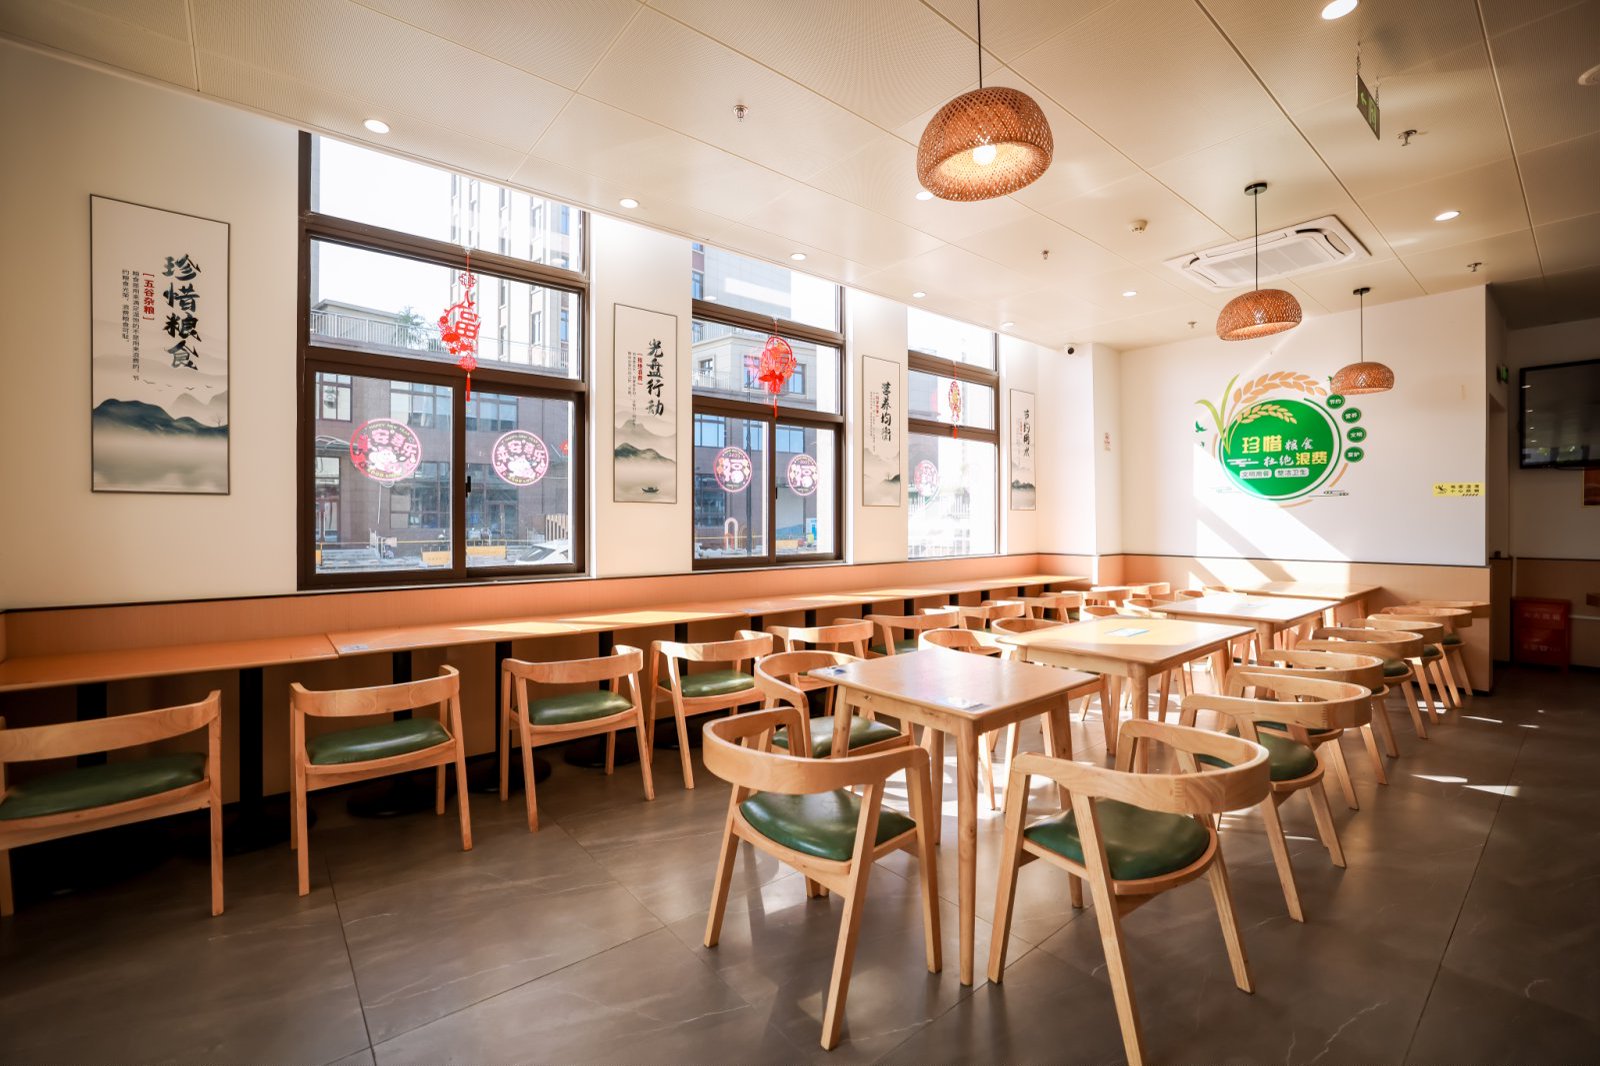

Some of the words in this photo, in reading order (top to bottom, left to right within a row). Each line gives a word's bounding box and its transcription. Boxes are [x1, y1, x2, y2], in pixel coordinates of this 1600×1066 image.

[162, 254, 202, 371] 珍惜粮食
[645, 338, 664, 416] 光盘行动
[880, 381, 892, 442] 营养均衡
[1242, 435, 1313, 454] 珍惜粮食
[1263, 451, 1327, 467] 杜绝浪费
